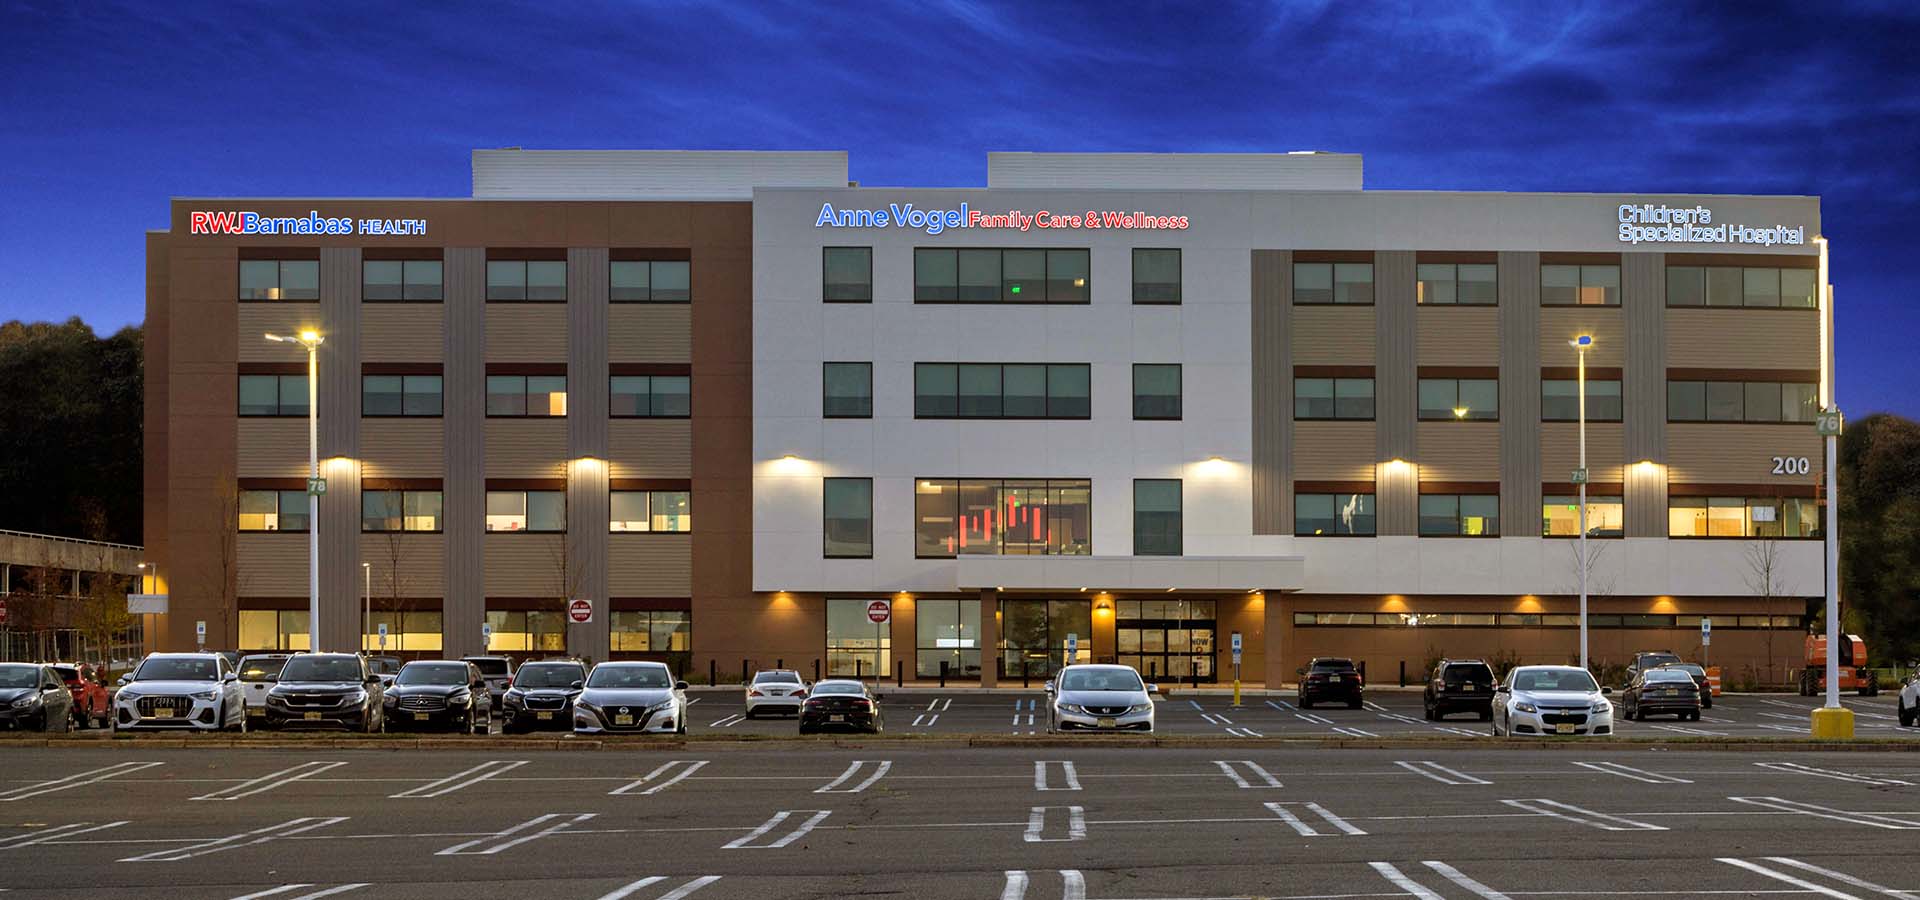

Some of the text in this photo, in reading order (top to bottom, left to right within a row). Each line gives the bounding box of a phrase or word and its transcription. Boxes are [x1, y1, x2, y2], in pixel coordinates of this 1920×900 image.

[816, 202, 968, 234] Anne Vogel
[968, 210, 1189, 232] Family Care & Wellness
[1618, 205, 1711, 223] Children's
[358, 219, 426, 235] HEALTH
[1619, 223, 1803, 246] Specialized Hospital
[1817, 416, 1838, 431] 76
[1772, 457, 1809, 474] 200
[1571, 471, 1585, 481] 79
[309, 480, 325, 491] 78
